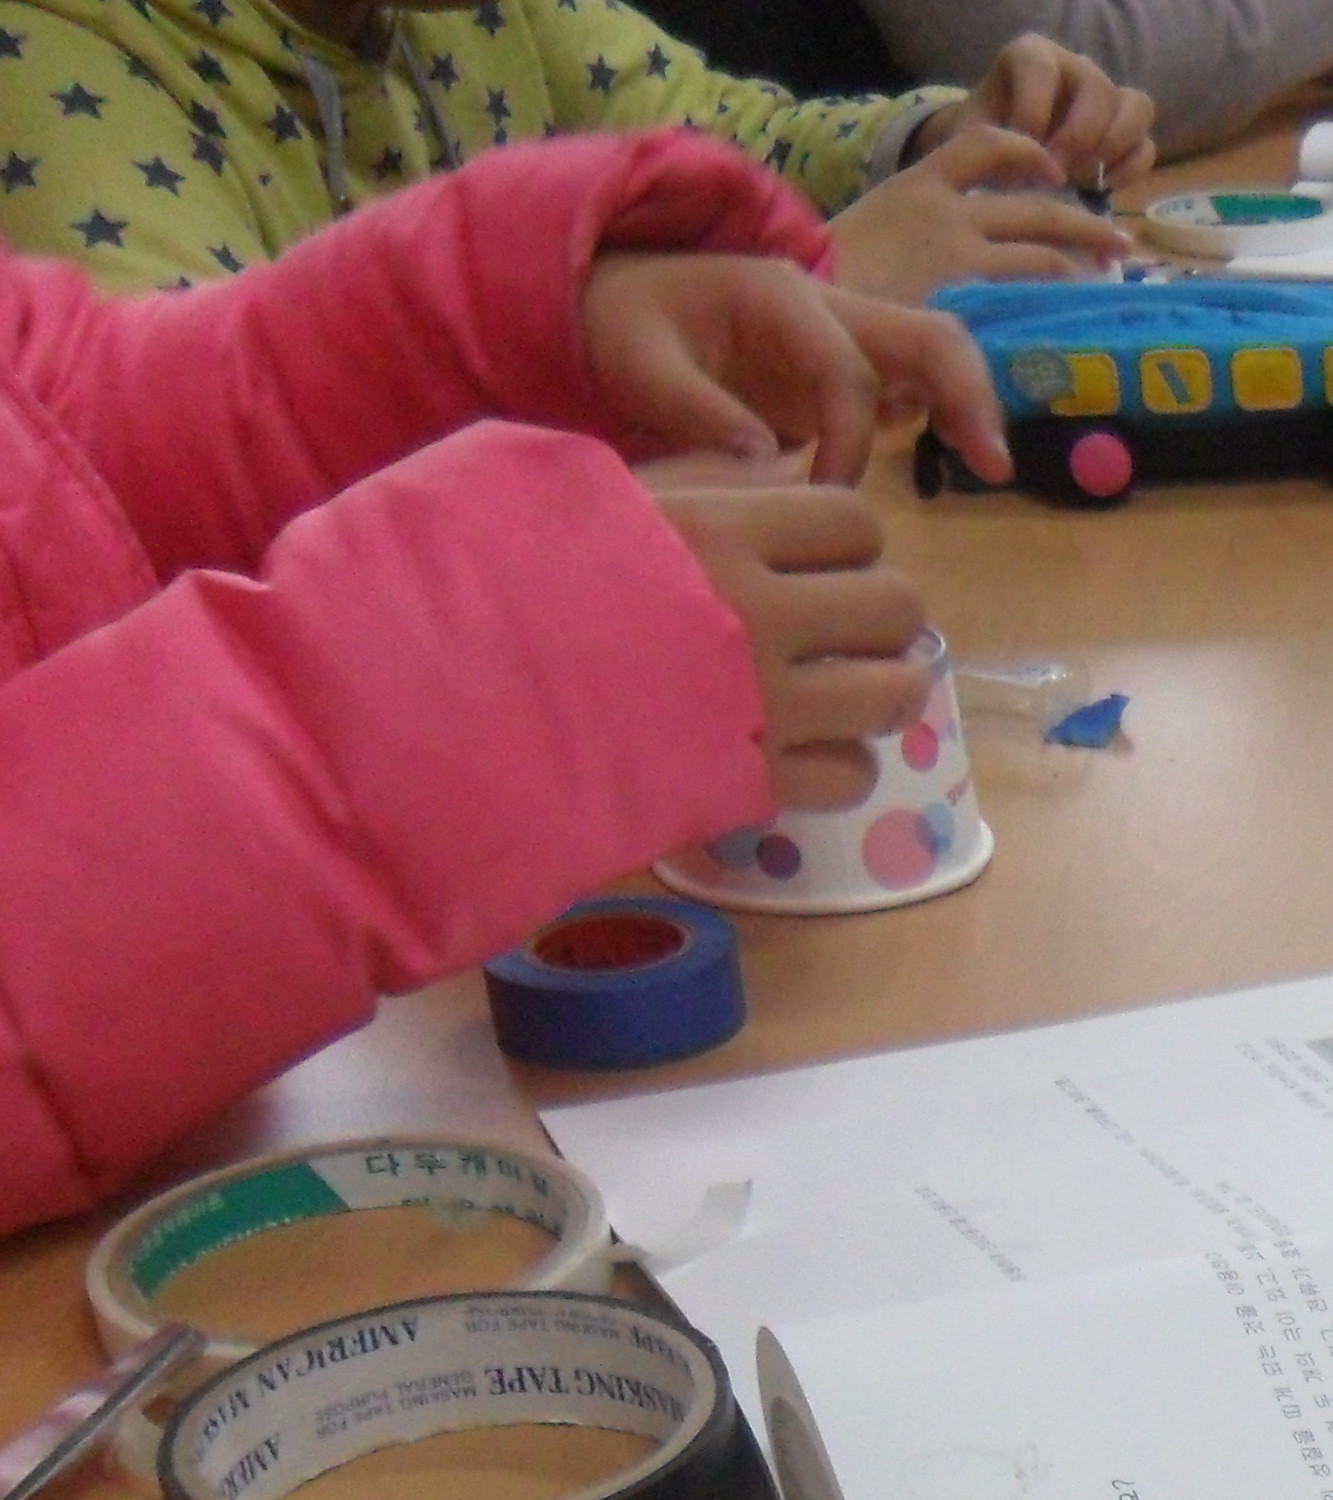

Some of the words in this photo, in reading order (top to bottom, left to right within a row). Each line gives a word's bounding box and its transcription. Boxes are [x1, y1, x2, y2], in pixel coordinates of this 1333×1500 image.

[1289, 1266, 1329, 1313] 전류가
[1274, 1310, 1301, 1342] 극이
[257, 1316, 419, 1398] AMERICAN
[1293, 1350, 1324, 1384] 개의
[483, 1366, 570, 1396] TAPE
[593, 1368, 686, 1425] MASKING
[1291, 1427, 1332, 1478] 성질을
